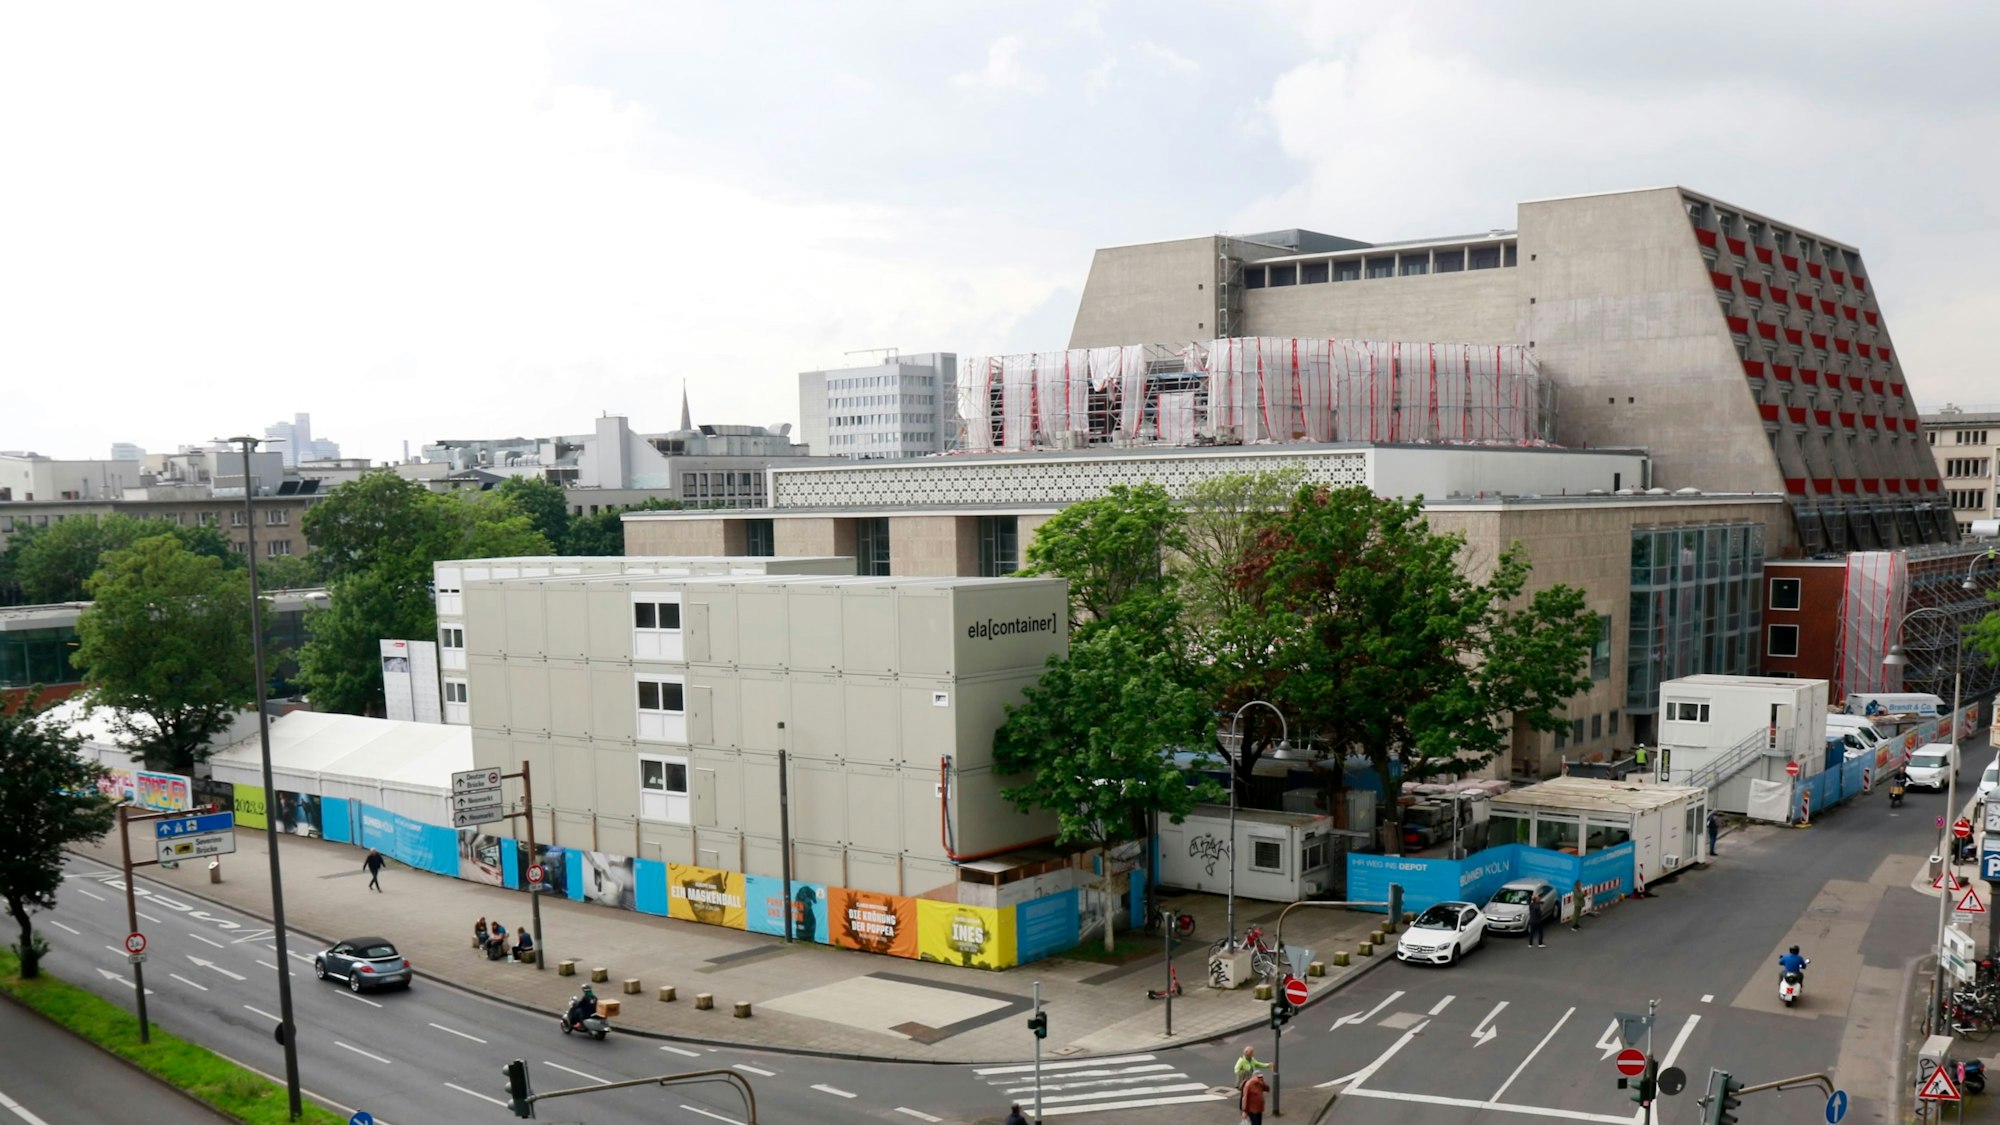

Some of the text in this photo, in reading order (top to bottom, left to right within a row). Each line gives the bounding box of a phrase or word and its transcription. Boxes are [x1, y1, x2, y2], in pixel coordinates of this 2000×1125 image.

[967, 612, 1057, 640] ela[container]
[1888, 703, 1912, 711] Brandt
[466, 773, 486, 781] Deutzer
[466, 781, 485, 789] Brücke
[235, 798, 266, 816] 2023.2
[196, 845, 218, 855] Brücke
[1398, 862, 1428, 871] DEPOT
[1460, 867, 1484, 887] BÜHNEN
[1485, 859, 1510, 874] KÖLN
[670, 885, 687, 899] EIN
[687, 887, 742, 908] MASKENBALL
[848, 908, 897, 925] DIE KRÖNUNG
[851, 920, 895, 937] DER POPPEA
[952, 923, 984, 944] INES
